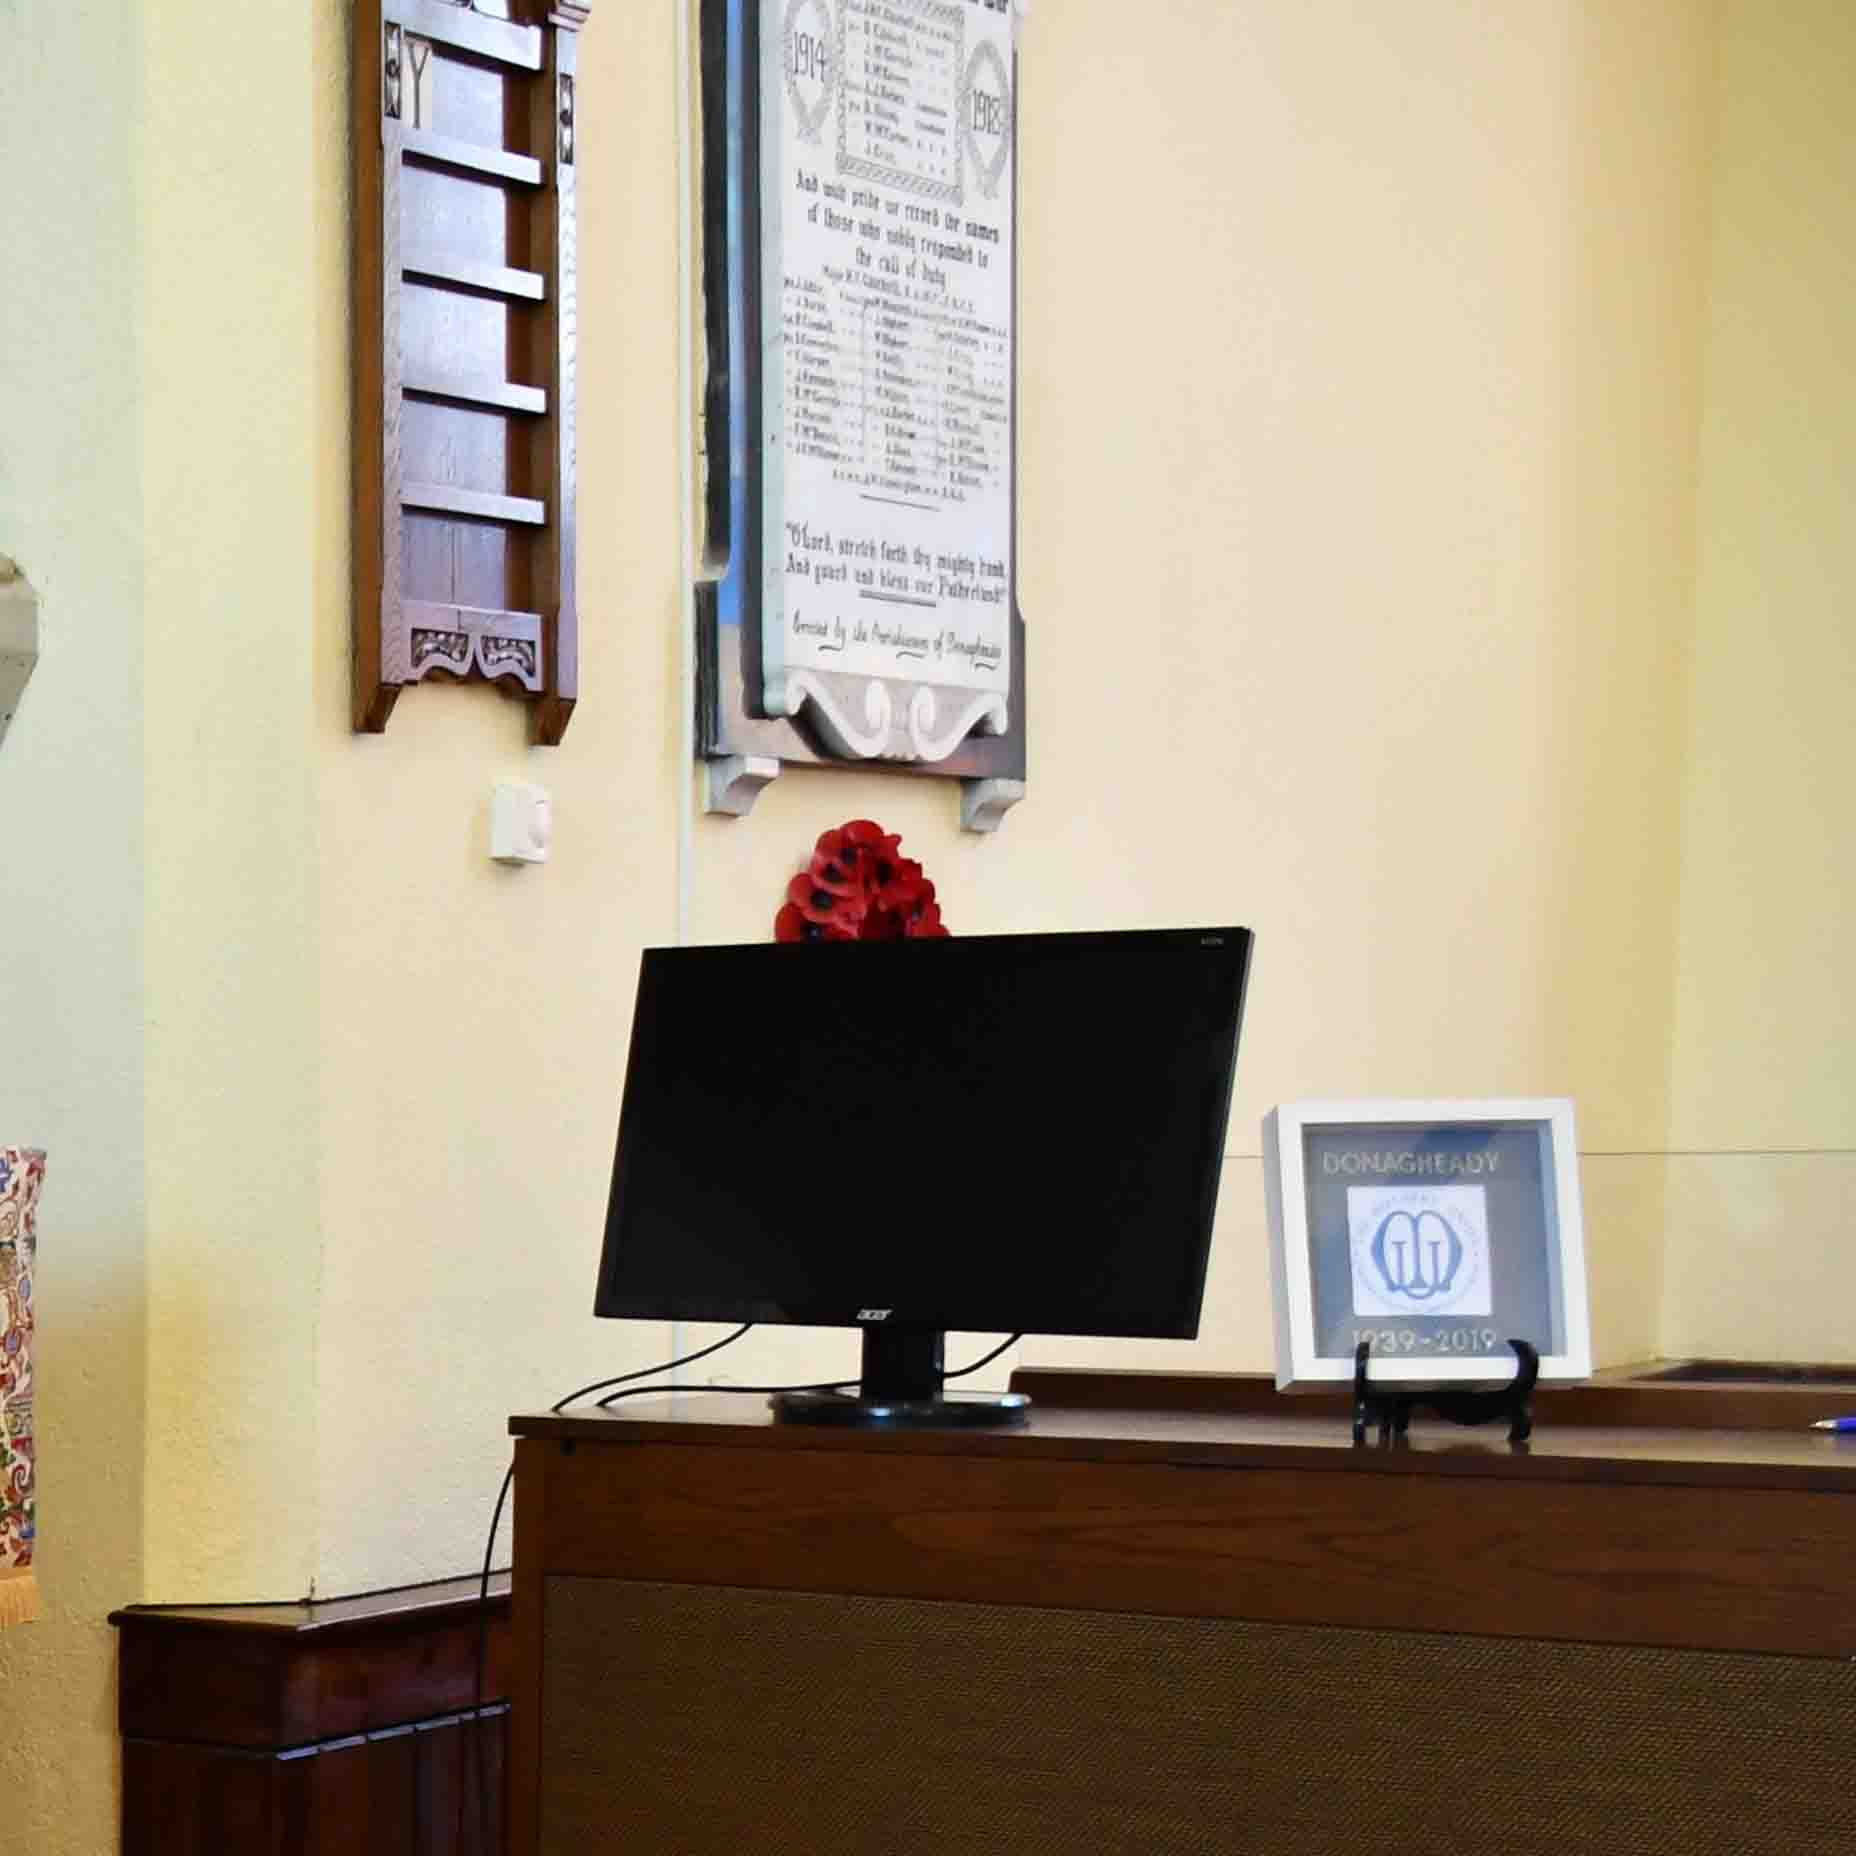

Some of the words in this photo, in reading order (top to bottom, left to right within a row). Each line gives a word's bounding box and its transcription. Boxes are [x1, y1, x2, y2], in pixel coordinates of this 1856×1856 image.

[792, 32, 825, 84] 1914
[971, 88, 1002, 136] 1918
[796, 168, 818, 192] And
[852, 190, 879, 210] pride
[905, 205, 939, 227] record
[965, 221, 999, 244] names
[807, 202, 819, 224] of
[824, 207, 854, 232] those
[855, 245, 871, 267] the
[881, 541, 907, 563] forth
[785, 552, 809, 576] And
[815, 559, 847, 584] guard
[880, 569, 909, 591] bless
[1323, 1151, 1500, 1176] DONAGHEADY
